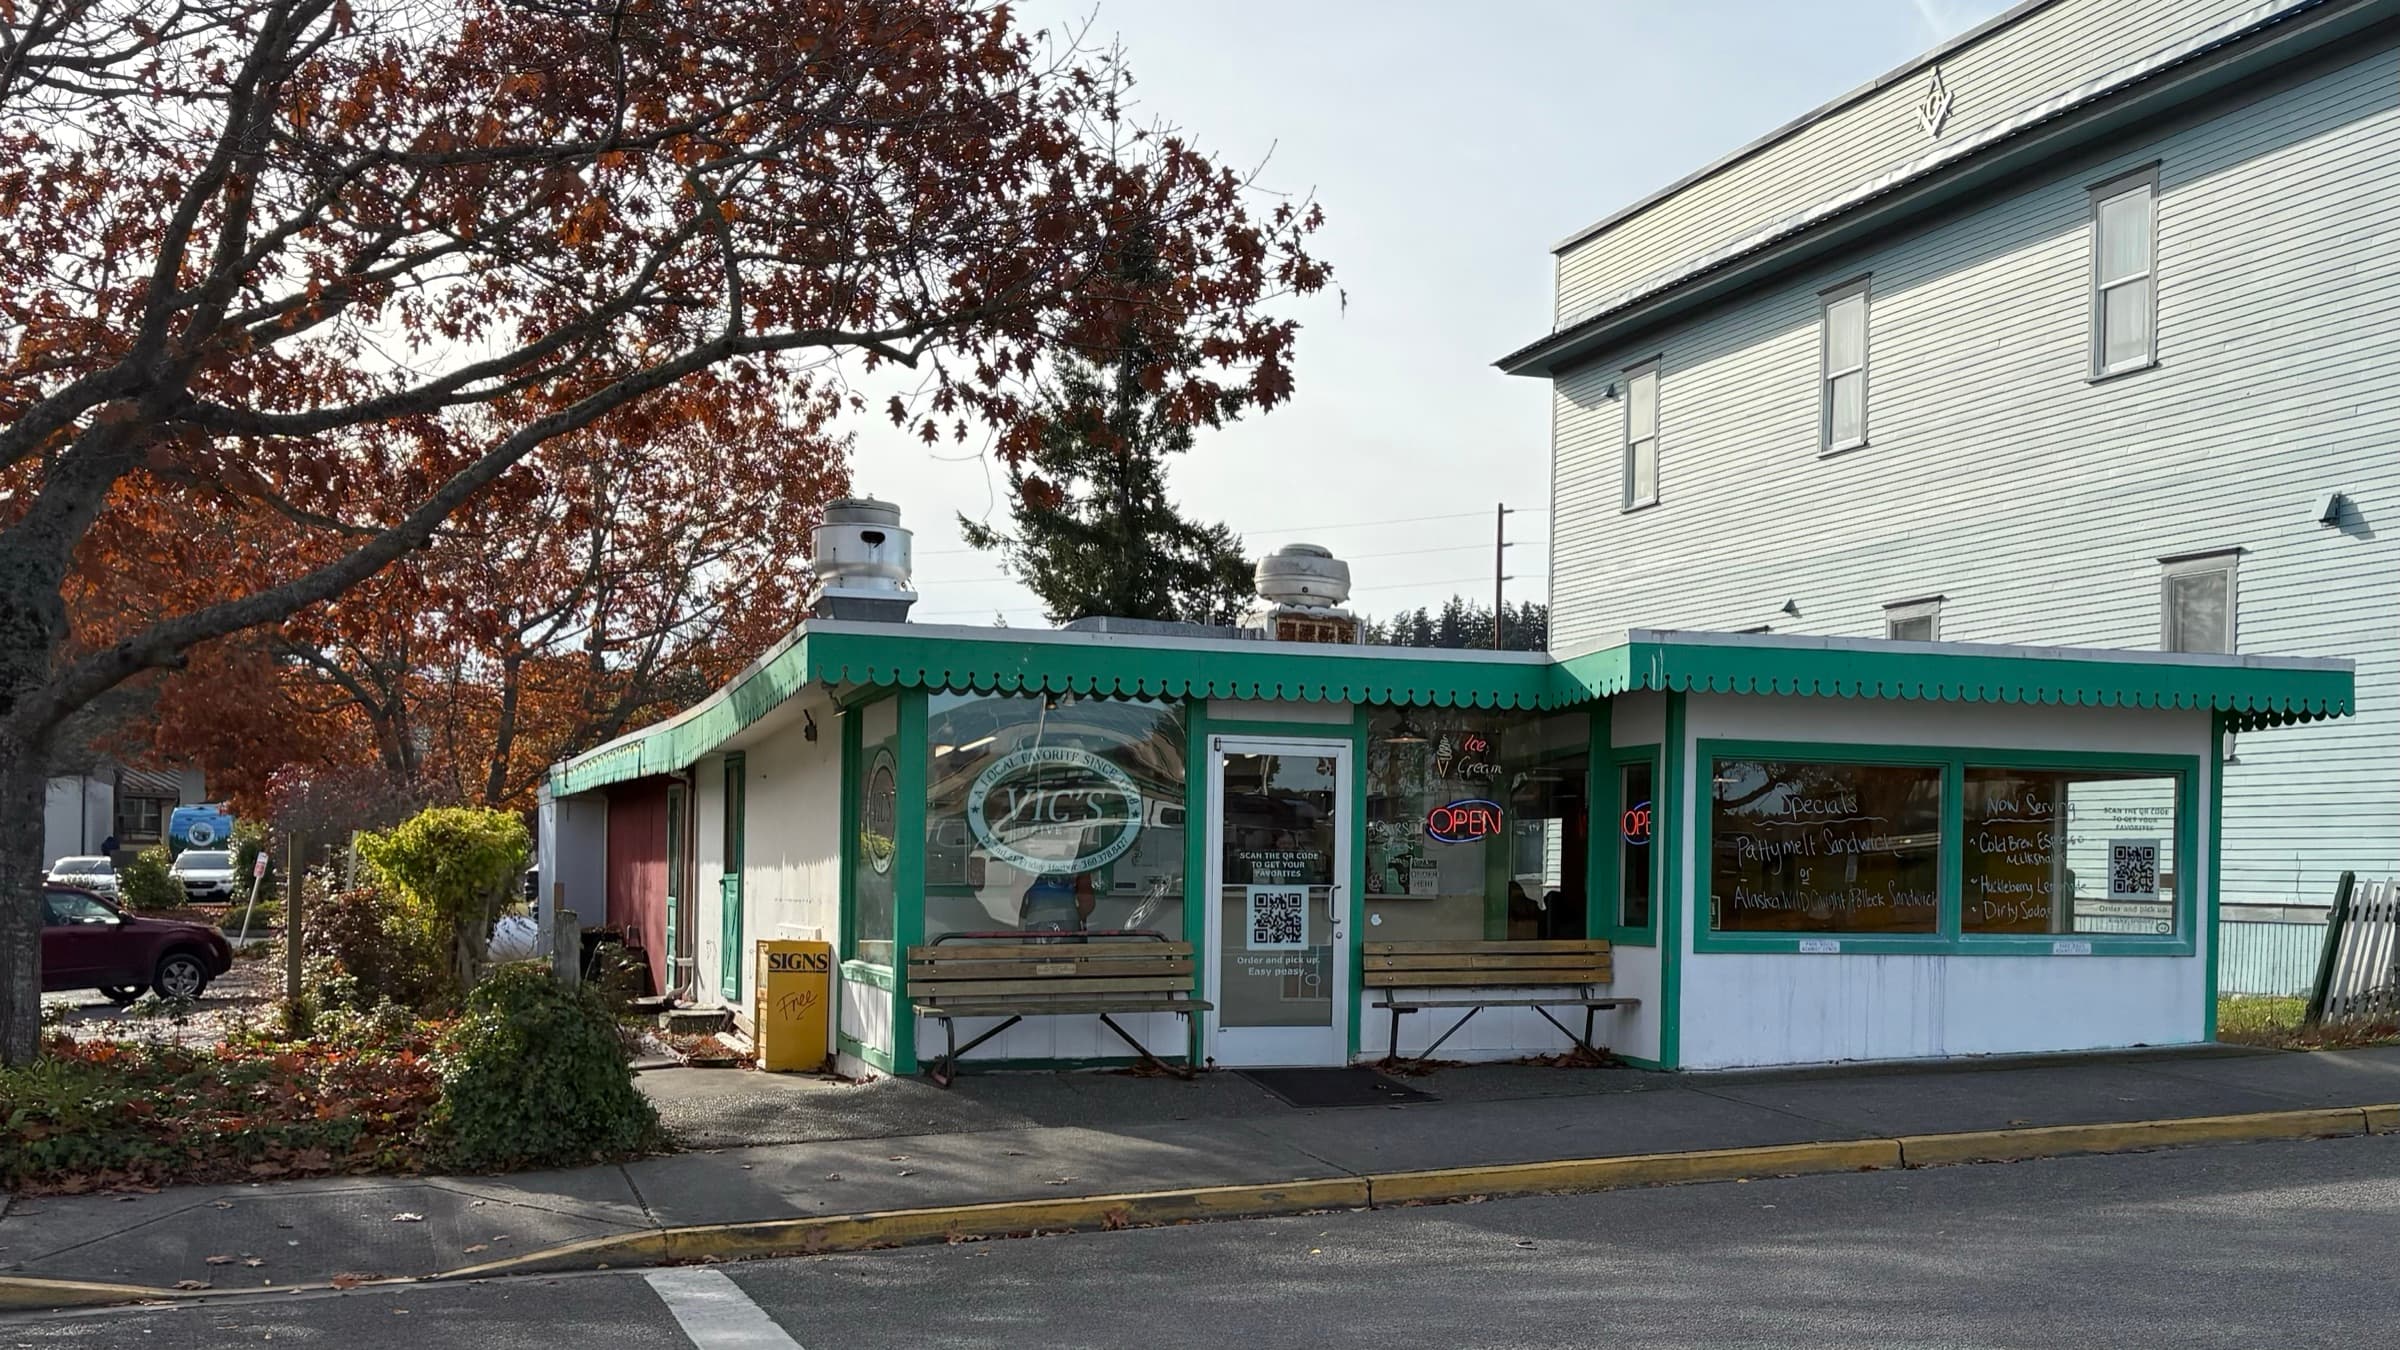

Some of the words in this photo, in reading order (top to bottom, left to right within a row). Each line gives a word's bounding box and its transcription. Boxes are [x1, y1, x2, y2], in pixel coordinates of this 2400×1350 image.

[1464, 734, 1487, 752] Ice
[980, 757, 1017, 785] LOCAL
[1021, 748, 1079, 764] FAVORITE
[1082, 754, 1118, 778] SINCE
[1457, 755, 1502, 775] Cream
[1007, 788, 1107, 823] VIC'S
[1775, 782, 1858, 821] Specials
[1429, 807, 1502, 835] OPEN
[1622, 810, 1652, 836] OPE
[1239, 852, 1262, 860] SCAN
[1282, 852, 1295, 860] QR
[1251, 861, 1263, 869] TO
[1264, 861, 1280, 869] GET
[1282, 861, 1305, 869] YOUR
[1734, 886, 1780, 910] Alaska
[1983, 900, 2018, 924] Dirty
[768, 953, 828, 970] SIGNS
[1237, 955, 1264, 965] Order
[1265, 955, 1283, 965] and
[1285, 955, 1304, 967] pick
[1248, 967, 1273, 977] Easy
[776, 990, 818, 1021] Free
